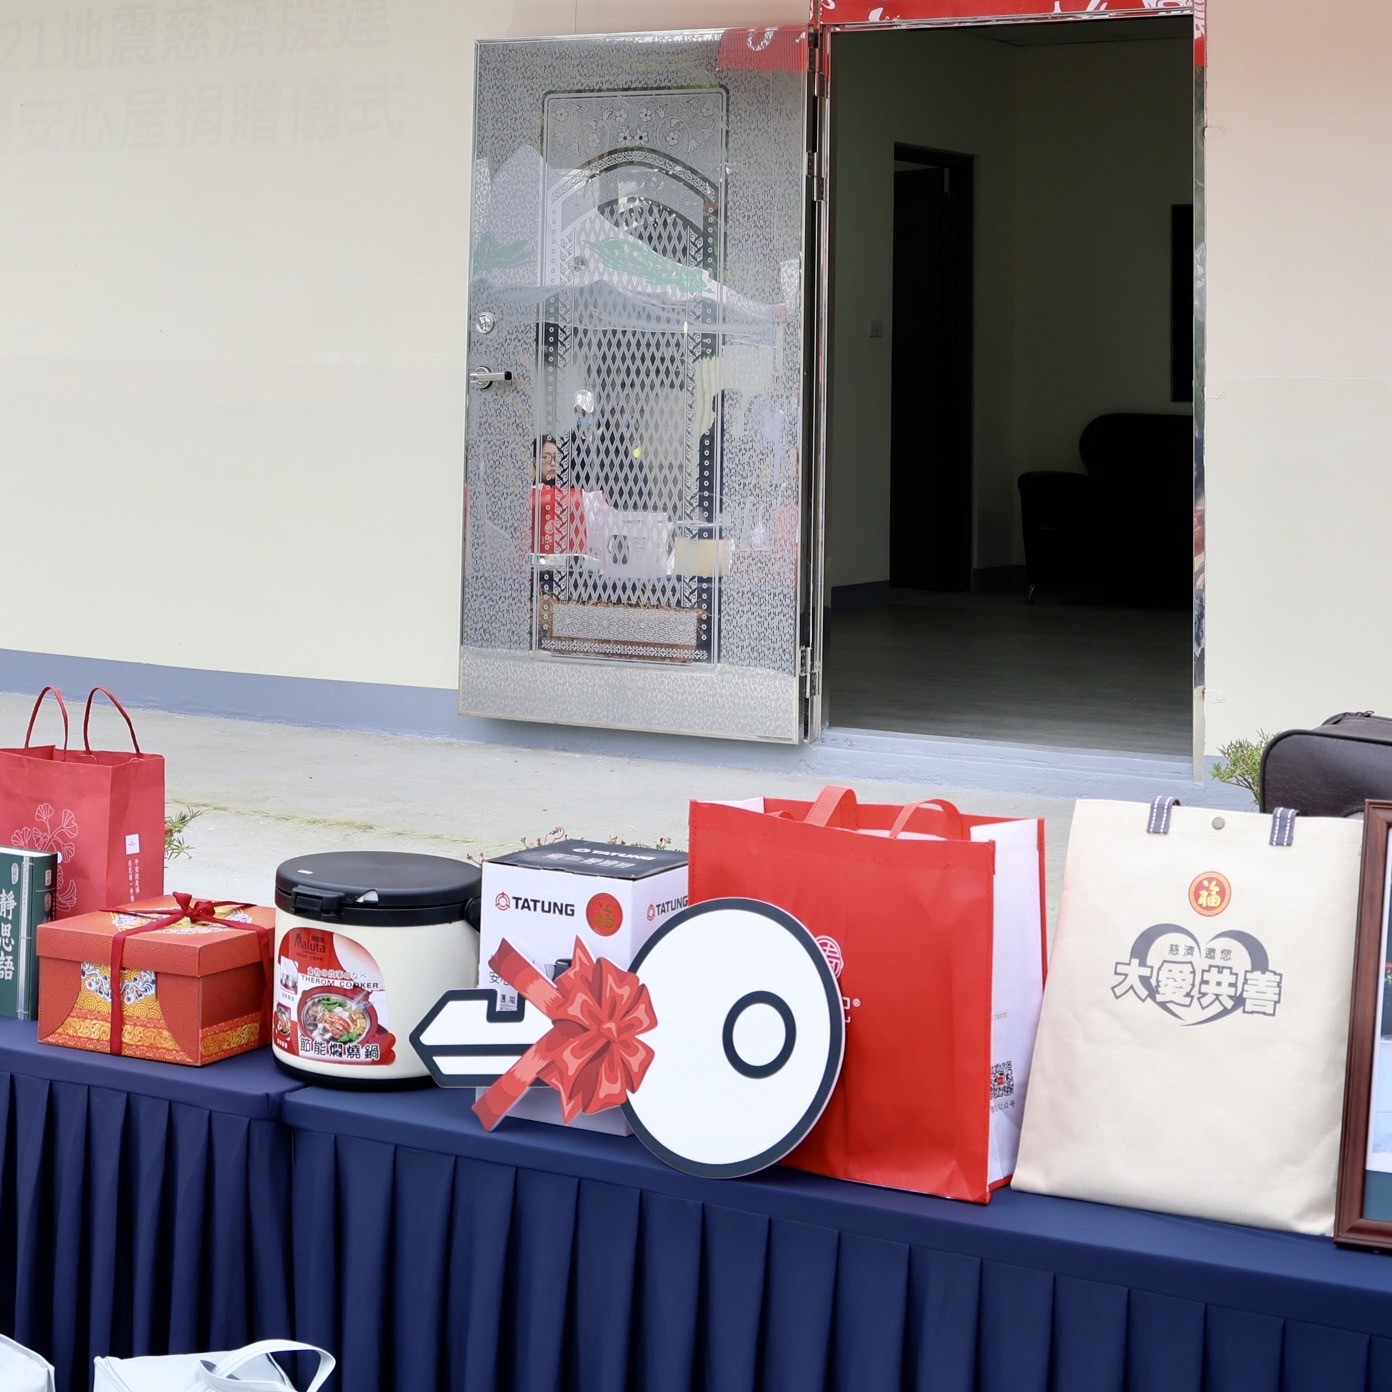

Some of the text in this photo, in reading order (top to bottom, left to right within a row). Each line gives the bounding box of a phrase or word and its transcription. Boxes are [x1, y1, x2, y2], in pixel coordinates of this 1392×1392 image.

[512, 896, 575, 917] TATUNG
[656, 895, 688, 916] TATUNG
[295, 933, 326, 954] Maluta
[301, 975, 379, 989] THEROM COOKER
[1111, 958, 1283, 1017] 大愛共善
